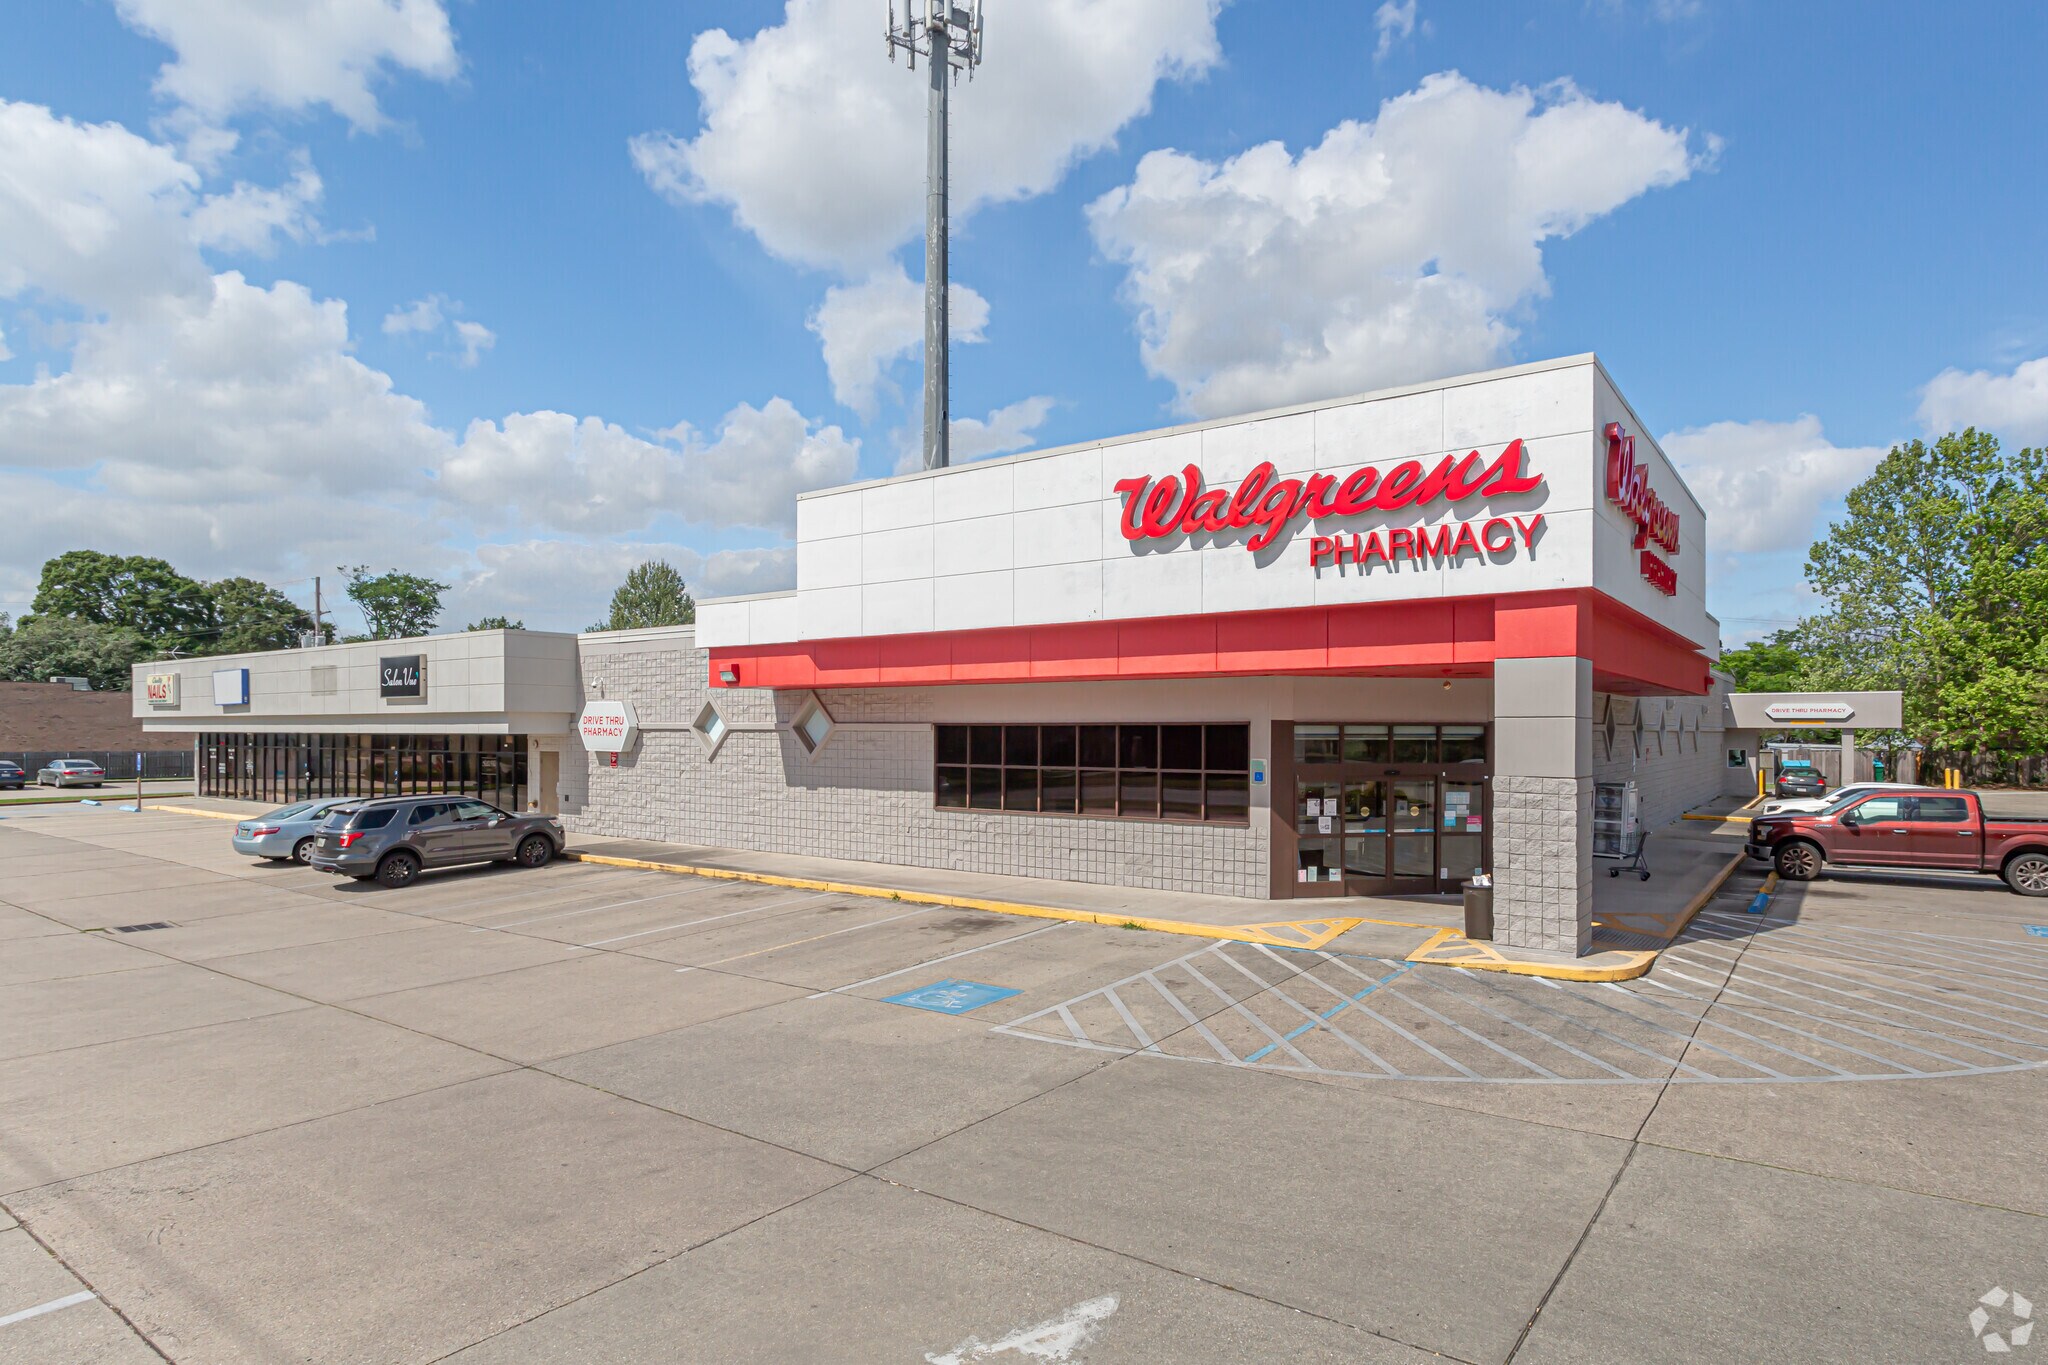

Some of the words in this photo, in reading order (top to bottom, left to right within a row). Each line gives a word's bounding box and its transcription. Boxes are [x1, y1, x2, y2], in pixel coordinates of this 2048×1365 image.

[1113, 438, 1544, 553] Walgreens
[1309, 513, 1544, 568] PHARMACY
[381, 668, 403, 687] Salon
[147, 684, 167, 699] NAILS
[583, 716, 604, 725] DRIVE
[605, 716, 625, 726] THRU
[583, 727, 624, 737] PHARMACY
